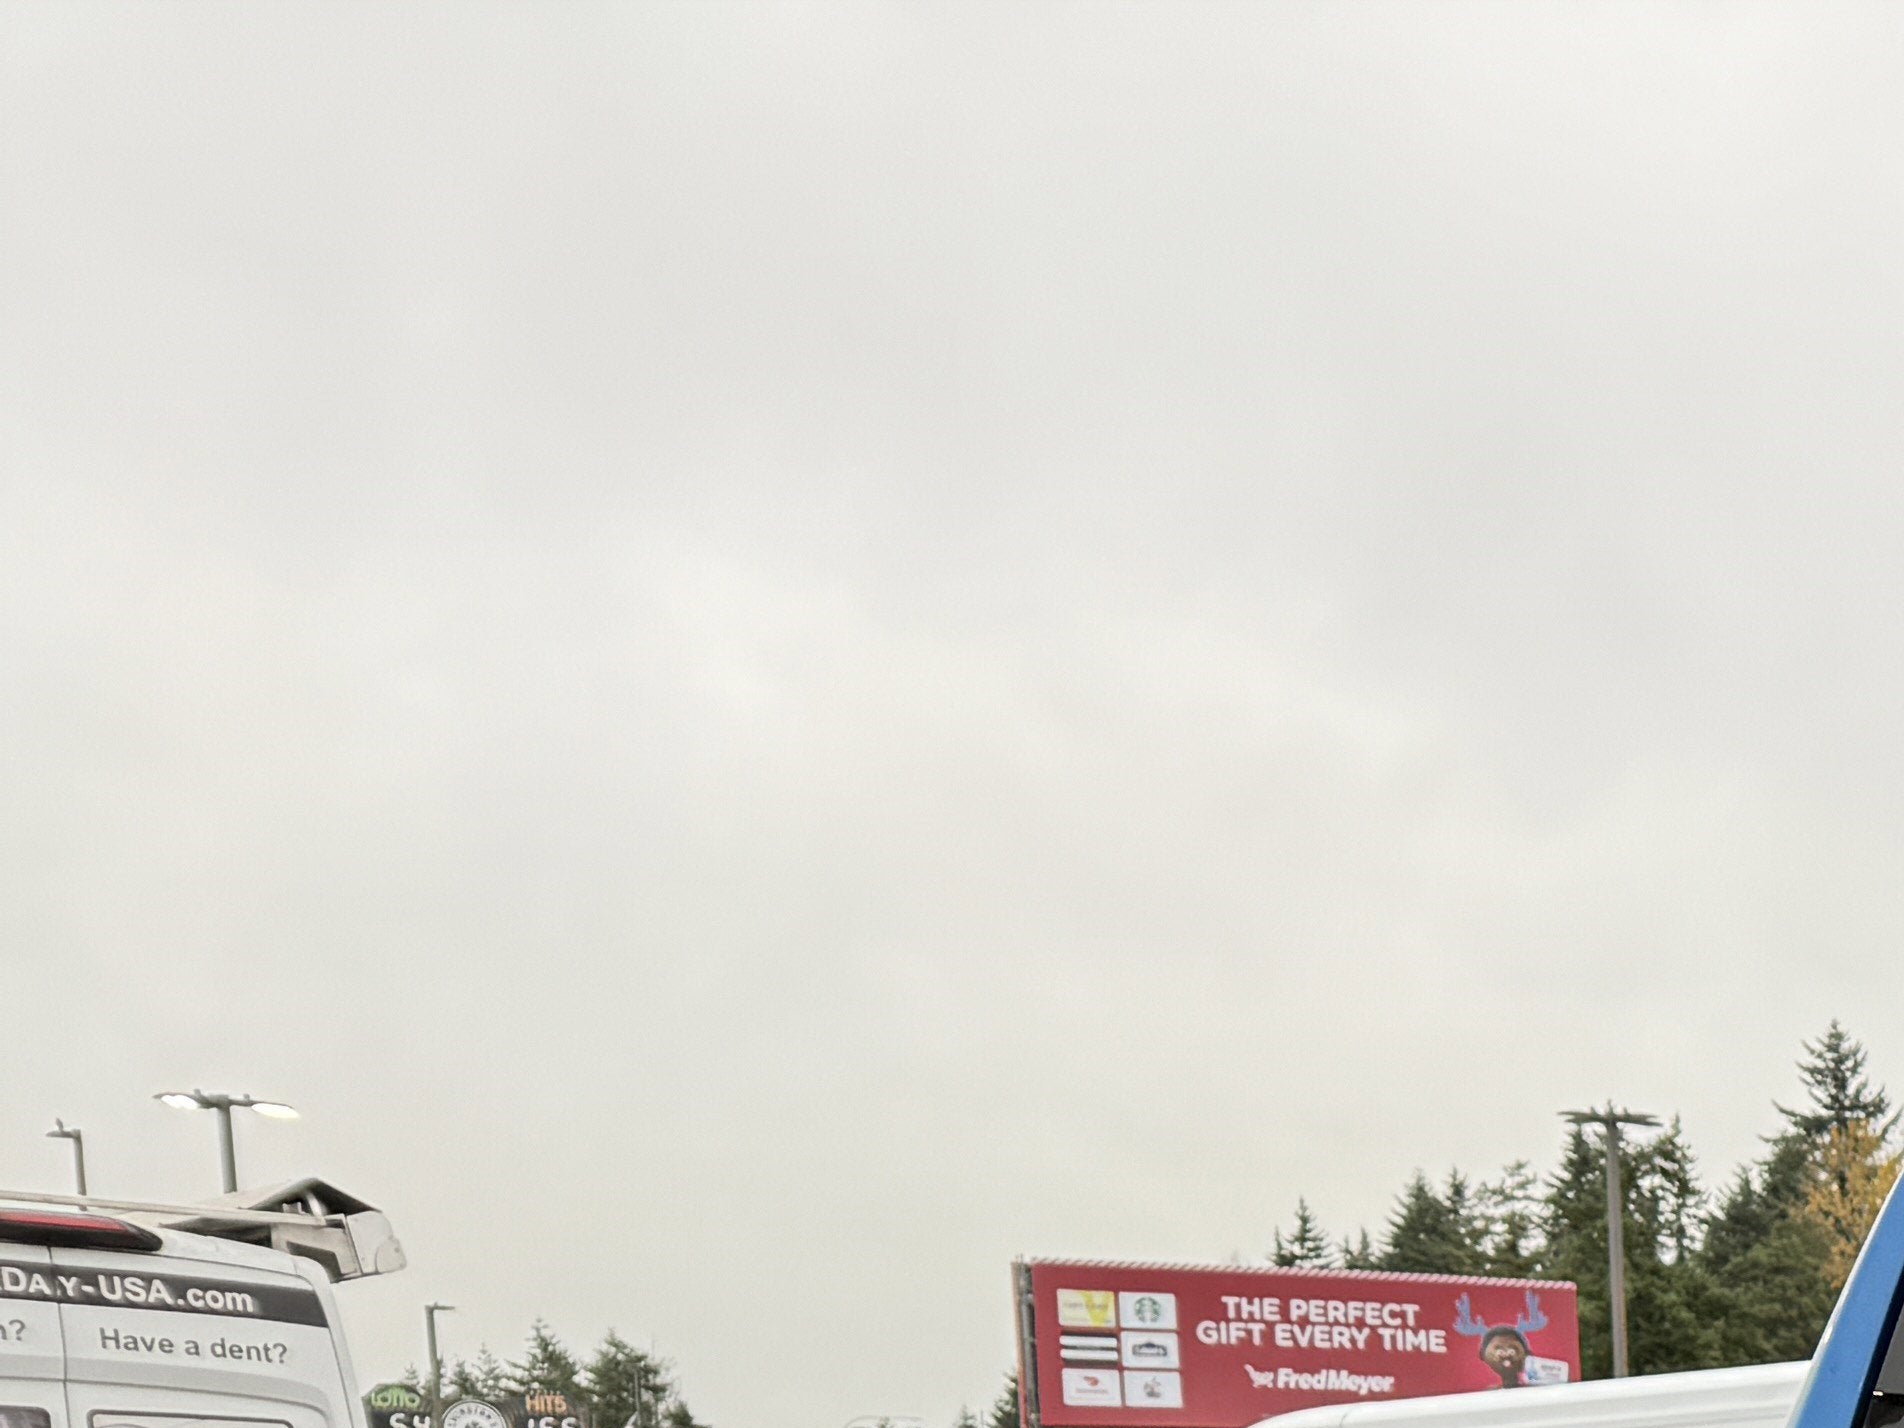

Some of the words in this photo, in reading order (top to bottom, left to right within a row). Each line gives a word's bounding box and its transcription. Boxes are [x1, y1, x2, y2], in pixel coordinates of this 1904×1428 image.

[0, 1266, 254, 1312] DAY-USA.com
[1221, 1296, 1281, 1321] THE
[1289, 1299, 1420, 1327] PERFECT
[99, 1327, 175, 1354] Have
[183, 1339, 201, 1356] a
[210, 1337, 288, 1364] dent?
[1196, 1320, 1266, 1346] GIFT
[1274, 1323, 1371, 1350] EVERY
[1377, 1327, 1448, 1353] TIME
